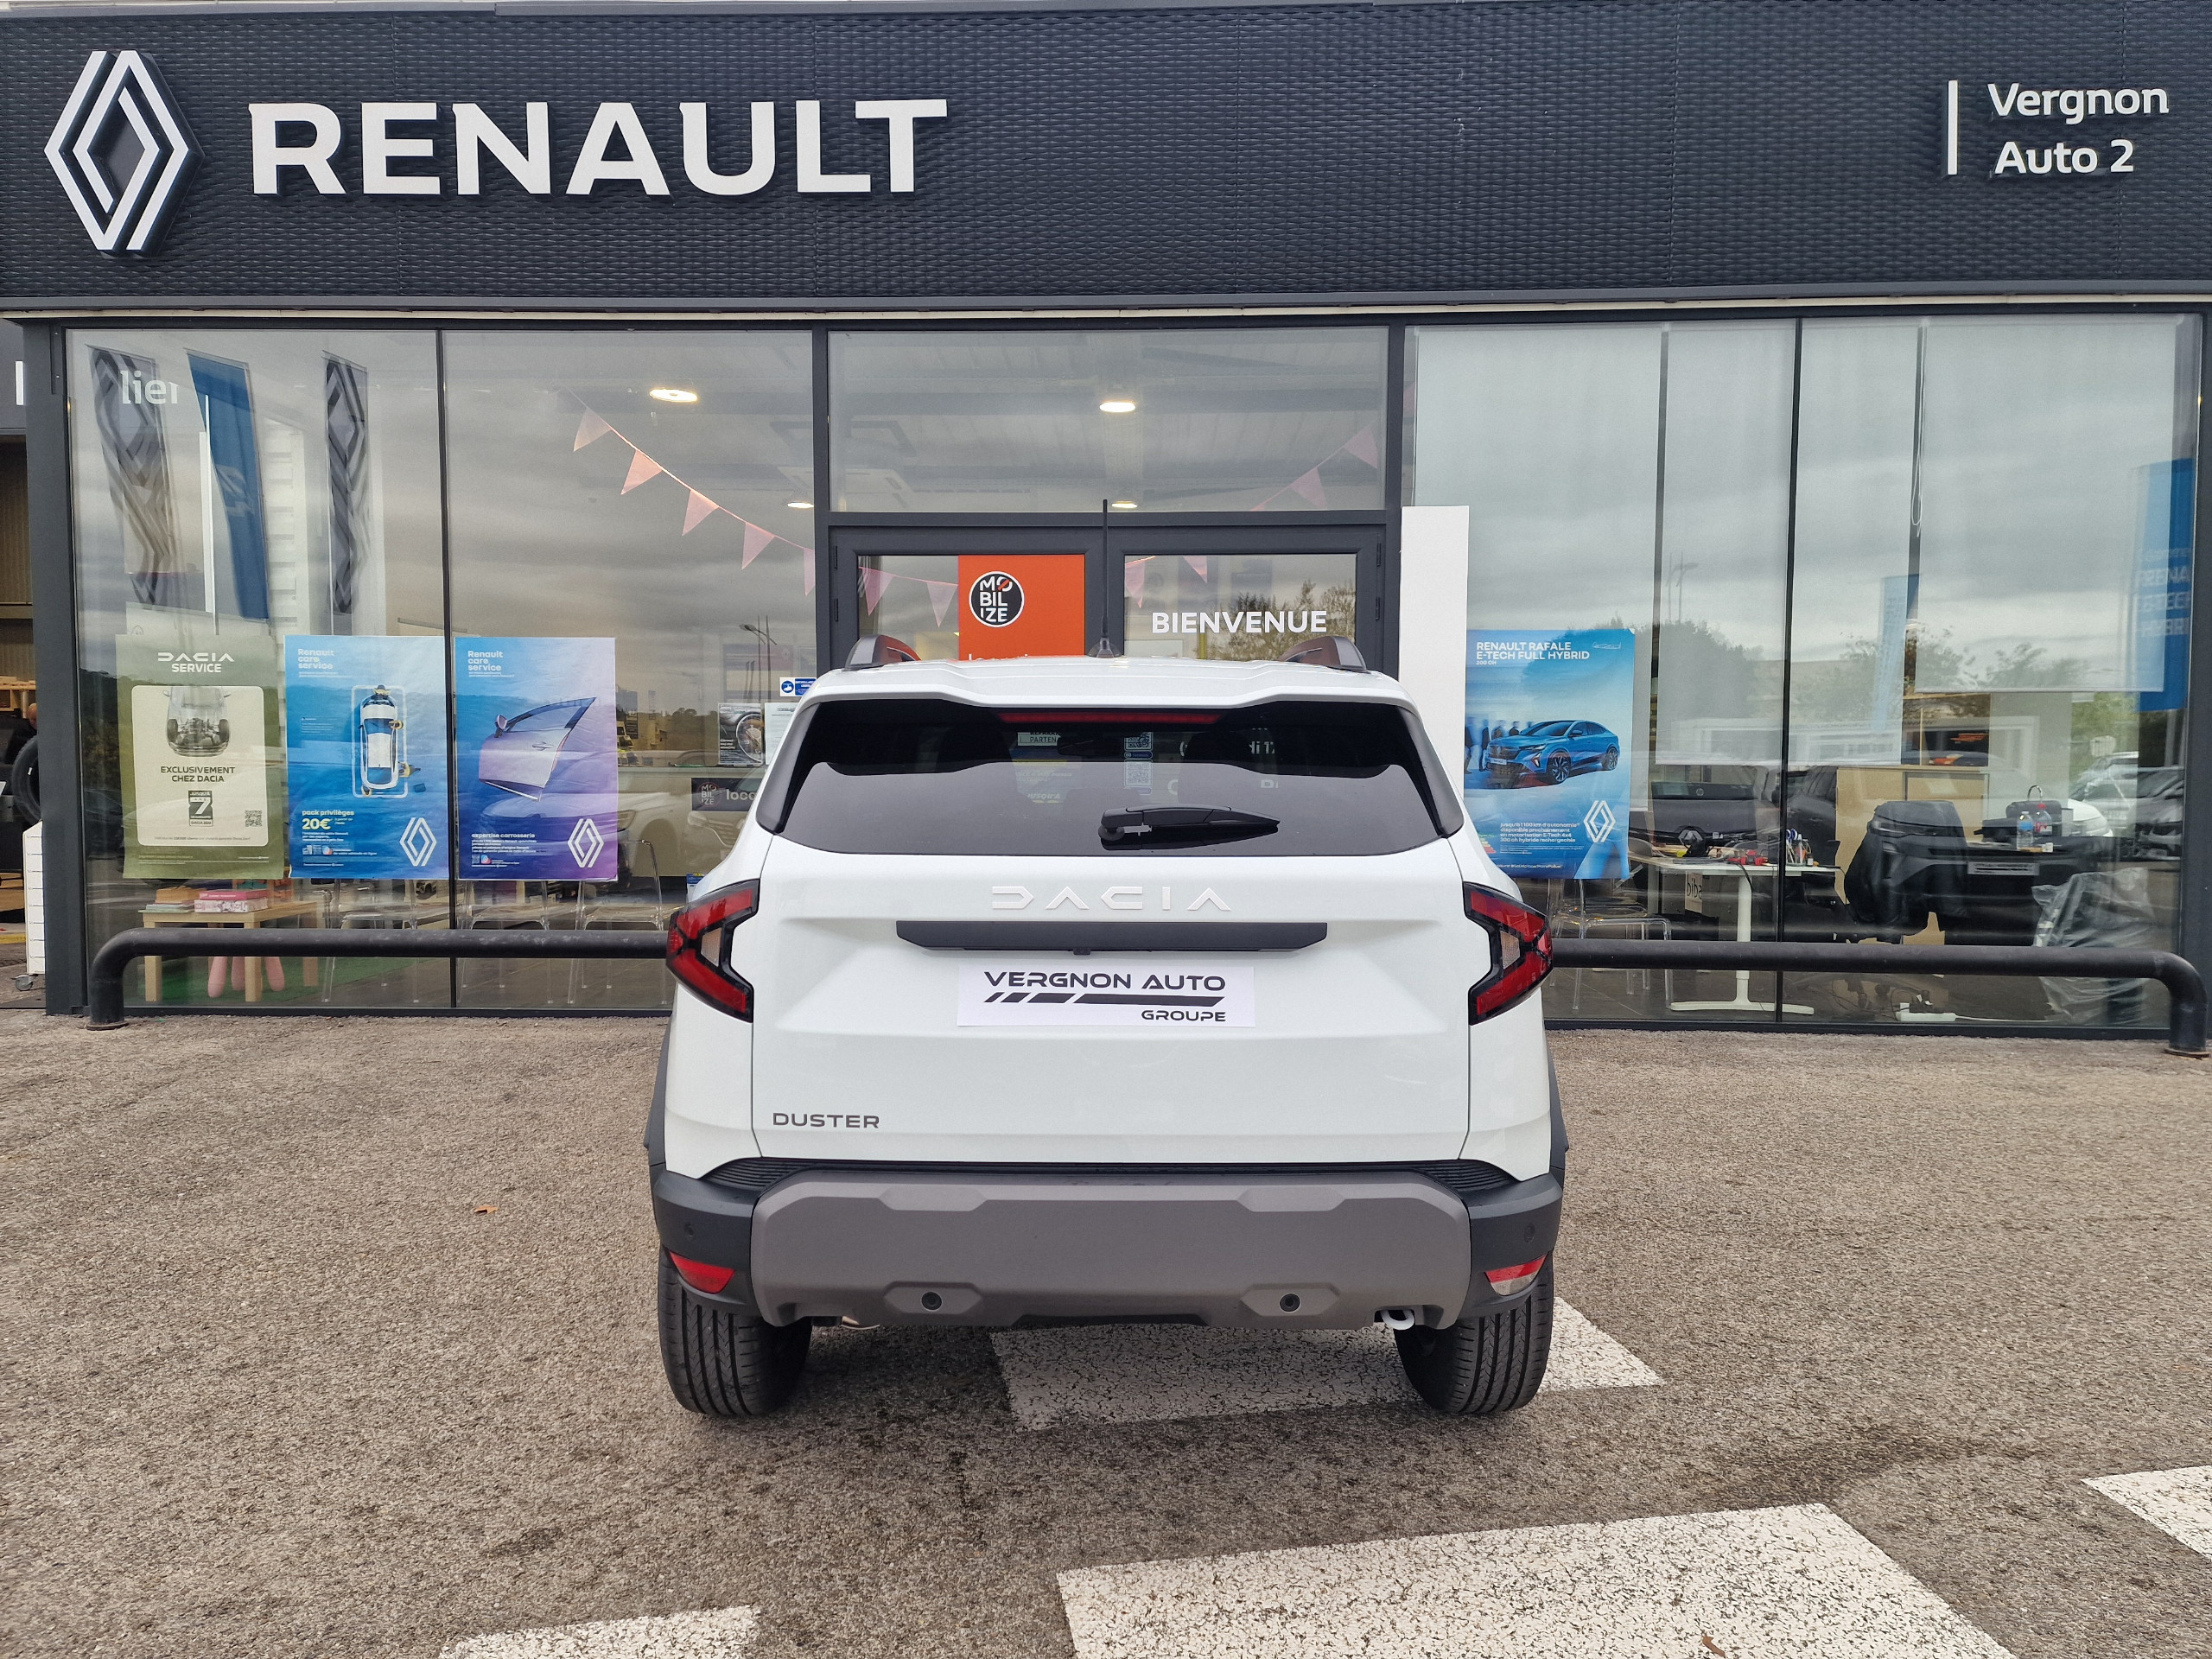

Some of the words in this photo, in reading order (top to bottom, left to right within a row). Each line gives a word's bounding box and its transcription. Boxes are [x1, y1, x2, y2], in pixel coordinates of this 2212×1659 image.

[1987, 83, 2170, 125] Vergnon
[248, 99, 948, 195] RENAULT
[1994, 141, 2099, 174] Auto
[2110, 139, 2134, 173] 2
[1152, 610, 1327, 633] BIENVENUE
[297, 648, 335, 657] Renault
[1476, 642, 1527, 651] RENAULT
[1529, 642, 1572, 651] RAFALE
[157, 652, 235, 663] DACIA
[467, 650, 504, 658] Renault
[1476, 651, 1516, 660] E-TECH
[1517, 652, 1546, 660] FULL
[1548, 652, 1591, 660] HYBRID
[171, 663, 222, 673] SERVICE
[160, 766, 236, 774] EXCLUSIVEMENT
[189, 797, 211, 815] 7
[320, 809, 355, 817] privilèges
[992, 886, 1231, 912] DACIA
[983, 971, 1132, 988] VERGNON
[1141, 975, 1226, 991] AUTO
[1141, 1010, 1227, 1022] GROUPE
[772, 1113, 880, 1128] DUSTER
